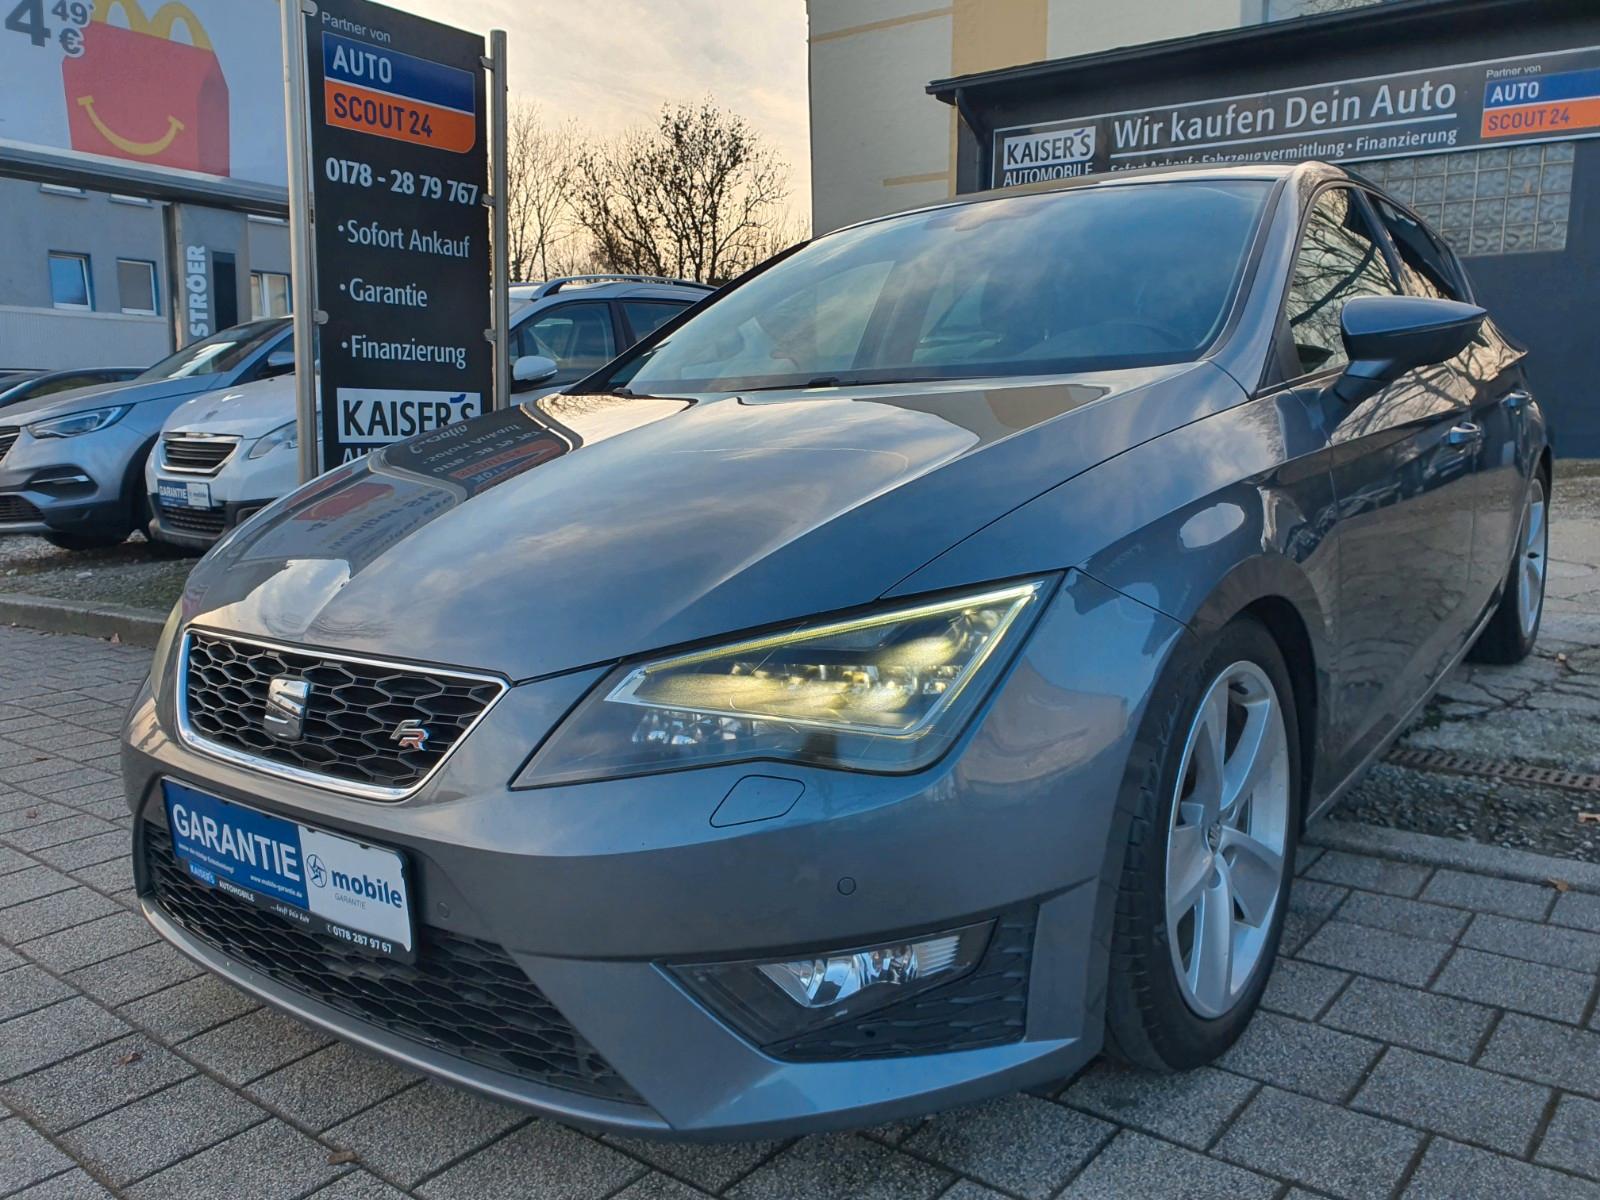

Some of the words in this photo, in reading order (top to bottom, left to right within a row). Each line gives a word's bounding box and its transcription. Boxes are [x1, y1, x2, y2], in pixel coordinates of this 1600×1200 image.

[5, 0, 51, 48] 4
[59, 28, 83, 54] €
[321, 11, 367, 36] Partner
[369, 29, 391, 43] von
[332, 45, 393, 84] AUTO
[1486, 67, 1521, 79] Partner
[1523, 65, 1542, 74] von
[1490, 81, 1540, 103] AUTO
[1113, 115, 1164, 148] Wir
[1170, 104, 1275, 142] kaufen
[1285, 89, 1361, 129] Dein
[1370, 80, 1457, 118] Auto
[1356, 129, 1457, 152] Finanzierung
[325, 157, 373, 188] 0178
[390, 169, 415, 195] 28
[419, 175, 442, 199] 79
[447, 180, 479, 206] 767
[347, 219, 405, 249] Sofort
[409, 229, 470, 258] Ankauf
[185, 245, 209, 337] STRÖER
[350, 278, 428, 307] Garantie
[351, 334, 466, 369] Finanzierung
[172, 803, 300, 882] GARANTIE
[332, 868, 403, 909] mobile
[334, 892, 367, 910] GARANTIE
[333, 925, 352, 941] 0178
[352, 931, 368, 946] 287
[382, 942, 392, 954] 67
